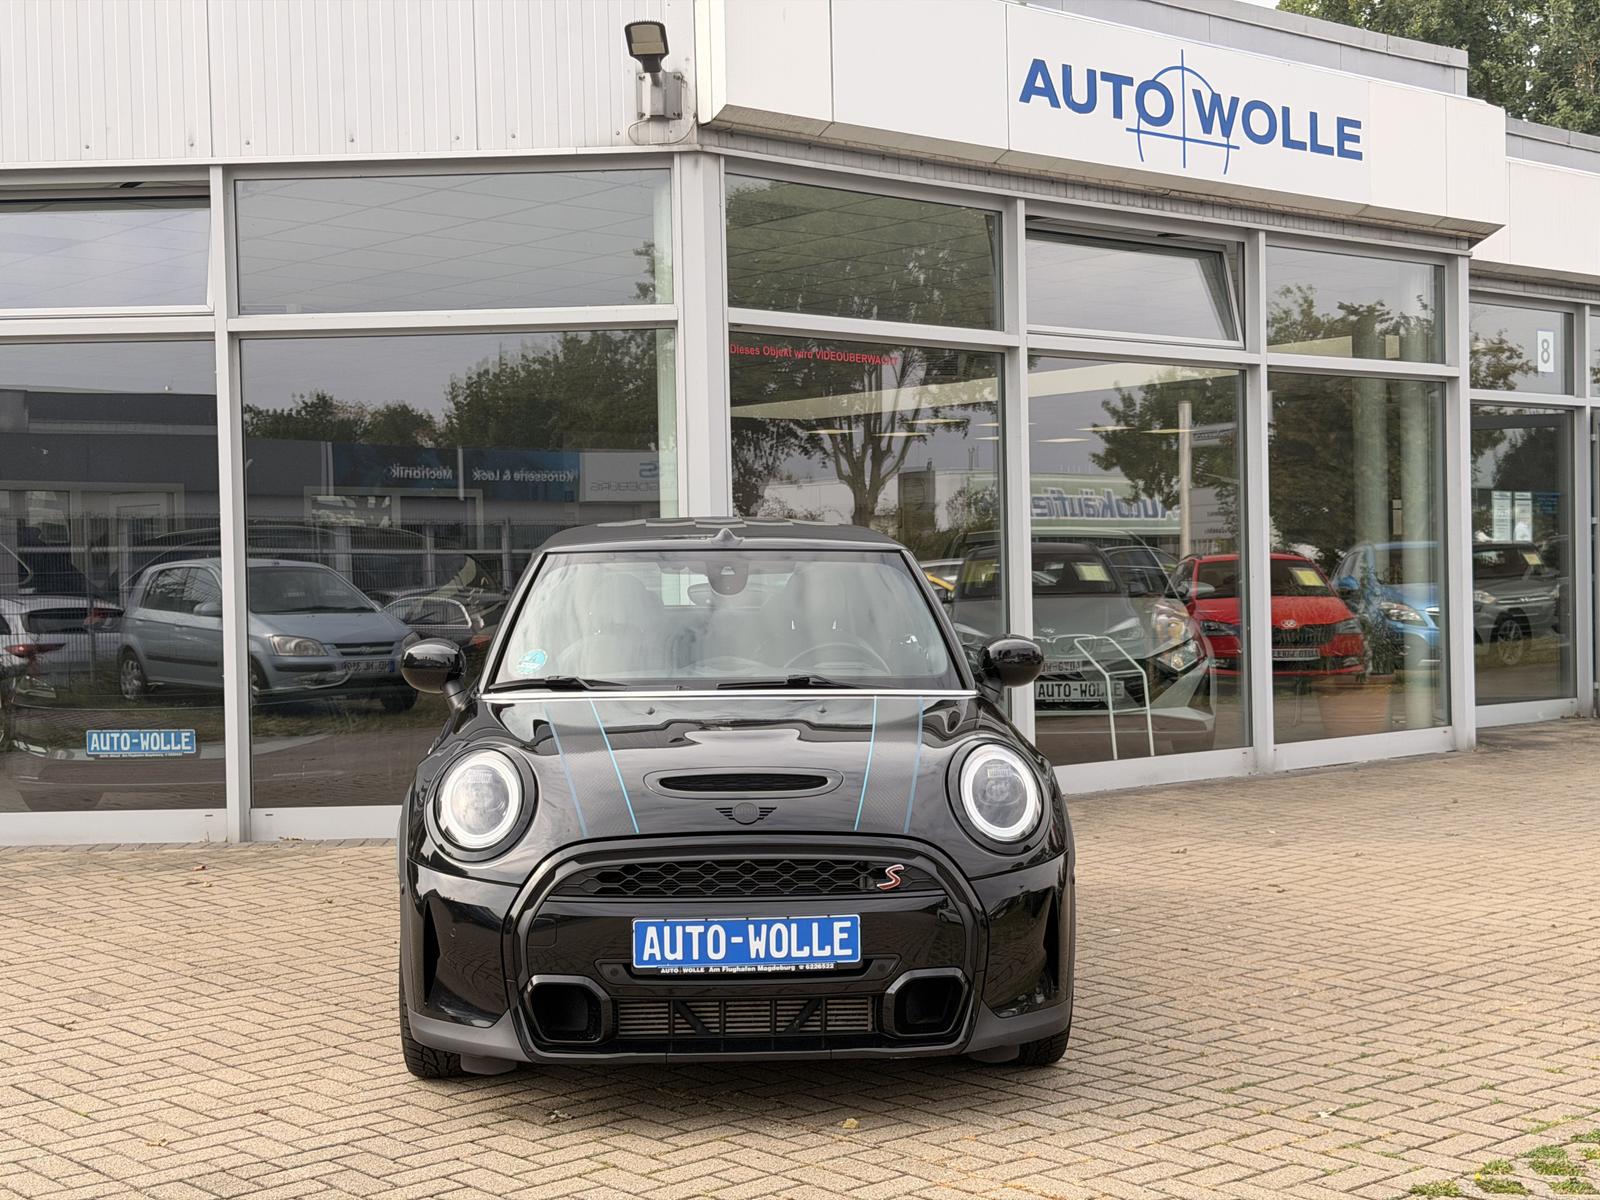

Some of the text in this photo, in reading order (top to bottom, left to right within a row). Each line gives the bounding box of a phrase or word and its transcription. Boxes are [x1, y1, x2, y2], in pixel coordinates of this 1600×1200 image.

[1019, 58, 1363, 161] AUTO WOLLE
[730, 344, 760, 355] Dieses
[763, 345, 793, 359] Objekt
[1540, 338, 1550, 364] 8
[90, 732, 192, 751] AUTO-WOLLE
[876, 864, 905, 890] S
[642, 921, 852, 961] AUTO-WOLLE
[722, 965, 756, 974] Flughafen
[757, 964, 796, 973] Magdeburg
